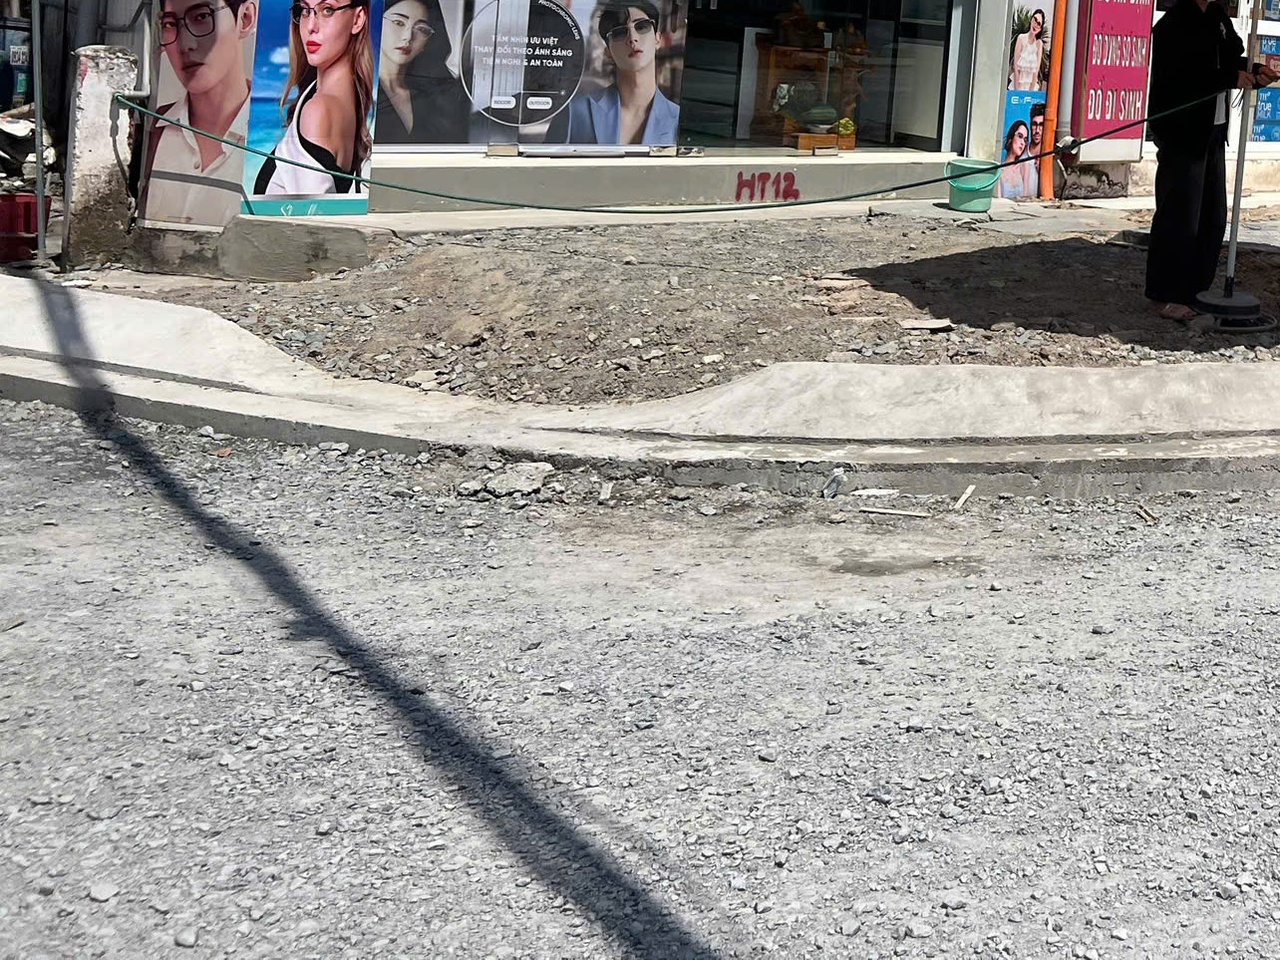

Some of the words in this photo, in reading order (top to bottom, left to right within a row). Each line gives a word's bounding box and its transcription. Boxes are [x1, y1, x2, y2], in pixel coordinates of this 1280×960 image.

[1105, 89, 1117, 121] ĐI
[1118, 90, 1143, 121] SINH
[1257, 100, 1272, 111] true
